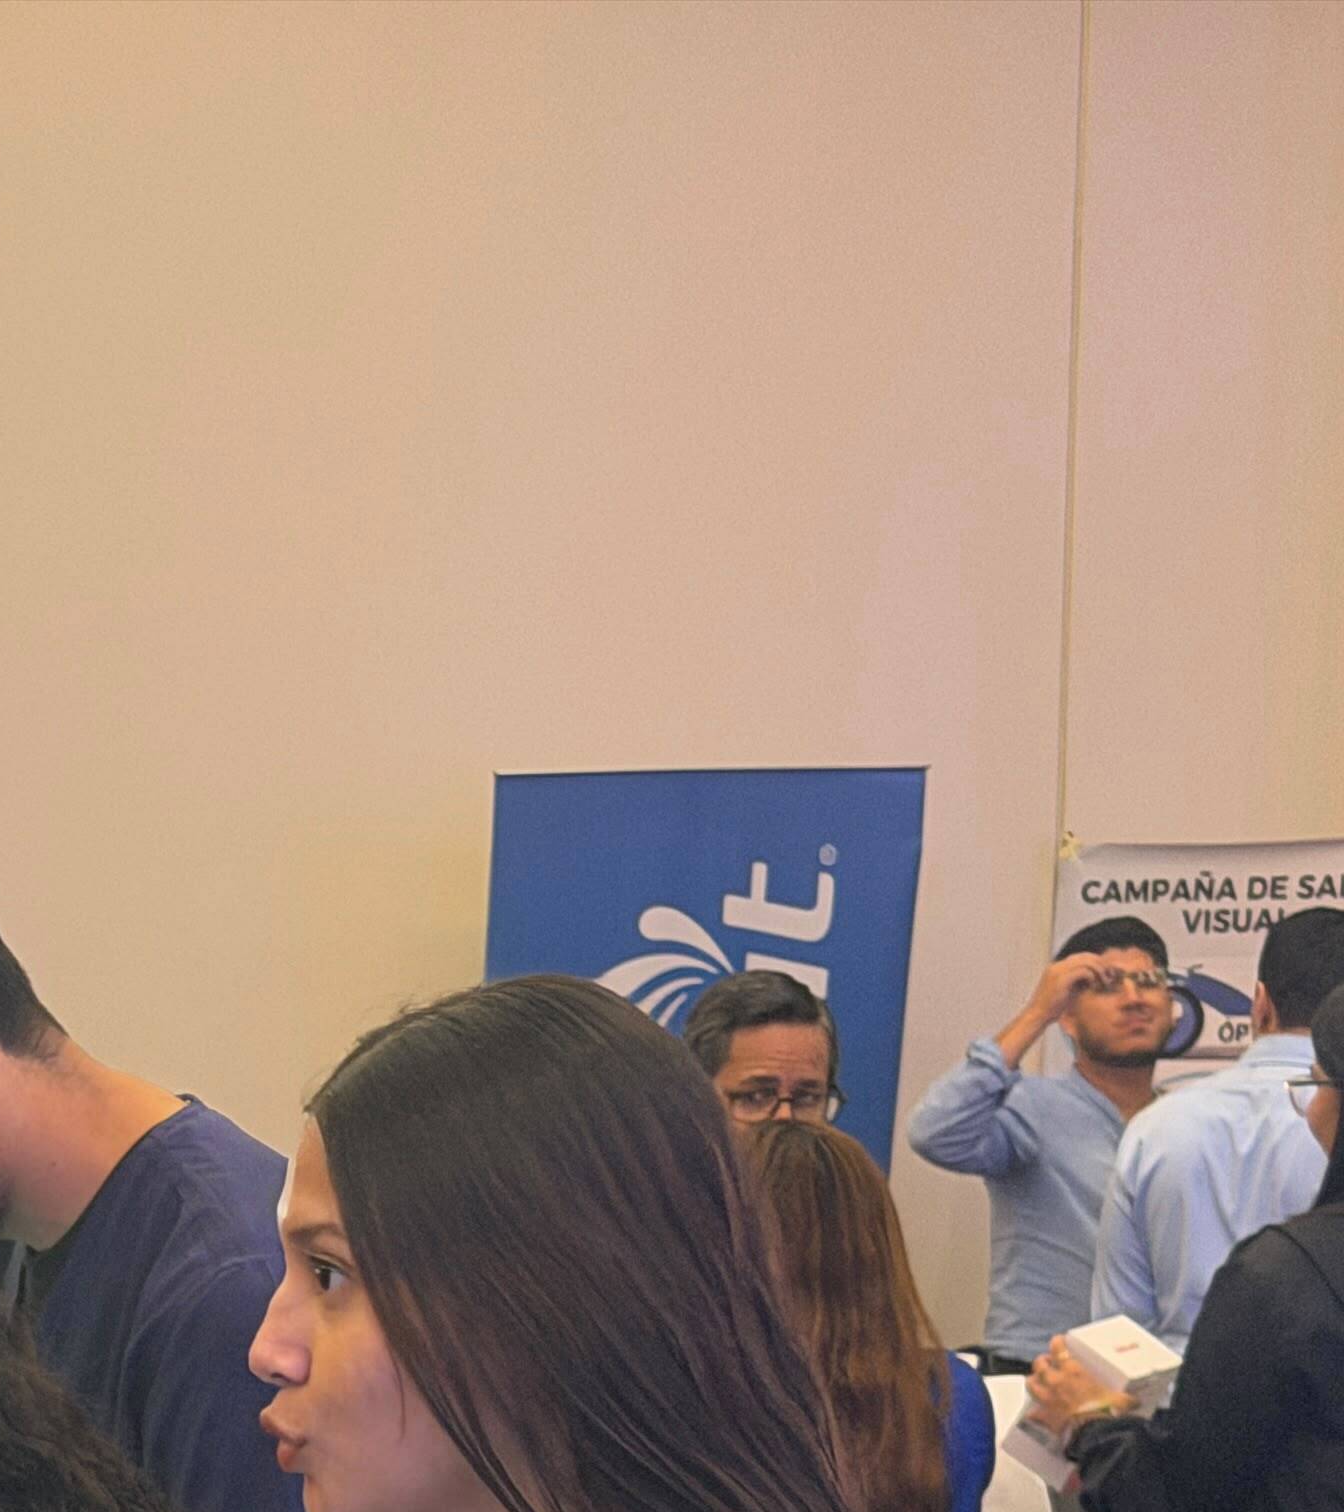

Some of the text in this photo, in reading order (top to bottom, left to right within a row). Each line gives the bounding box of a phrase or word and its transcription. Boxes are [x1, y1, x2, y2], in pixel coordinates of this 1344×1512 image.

[1080, 870, 1238, 904] CAMPAÑA
[1246, 875, 1289, 901] DE
[1217, 1017, 1249, 1043] ÓP
